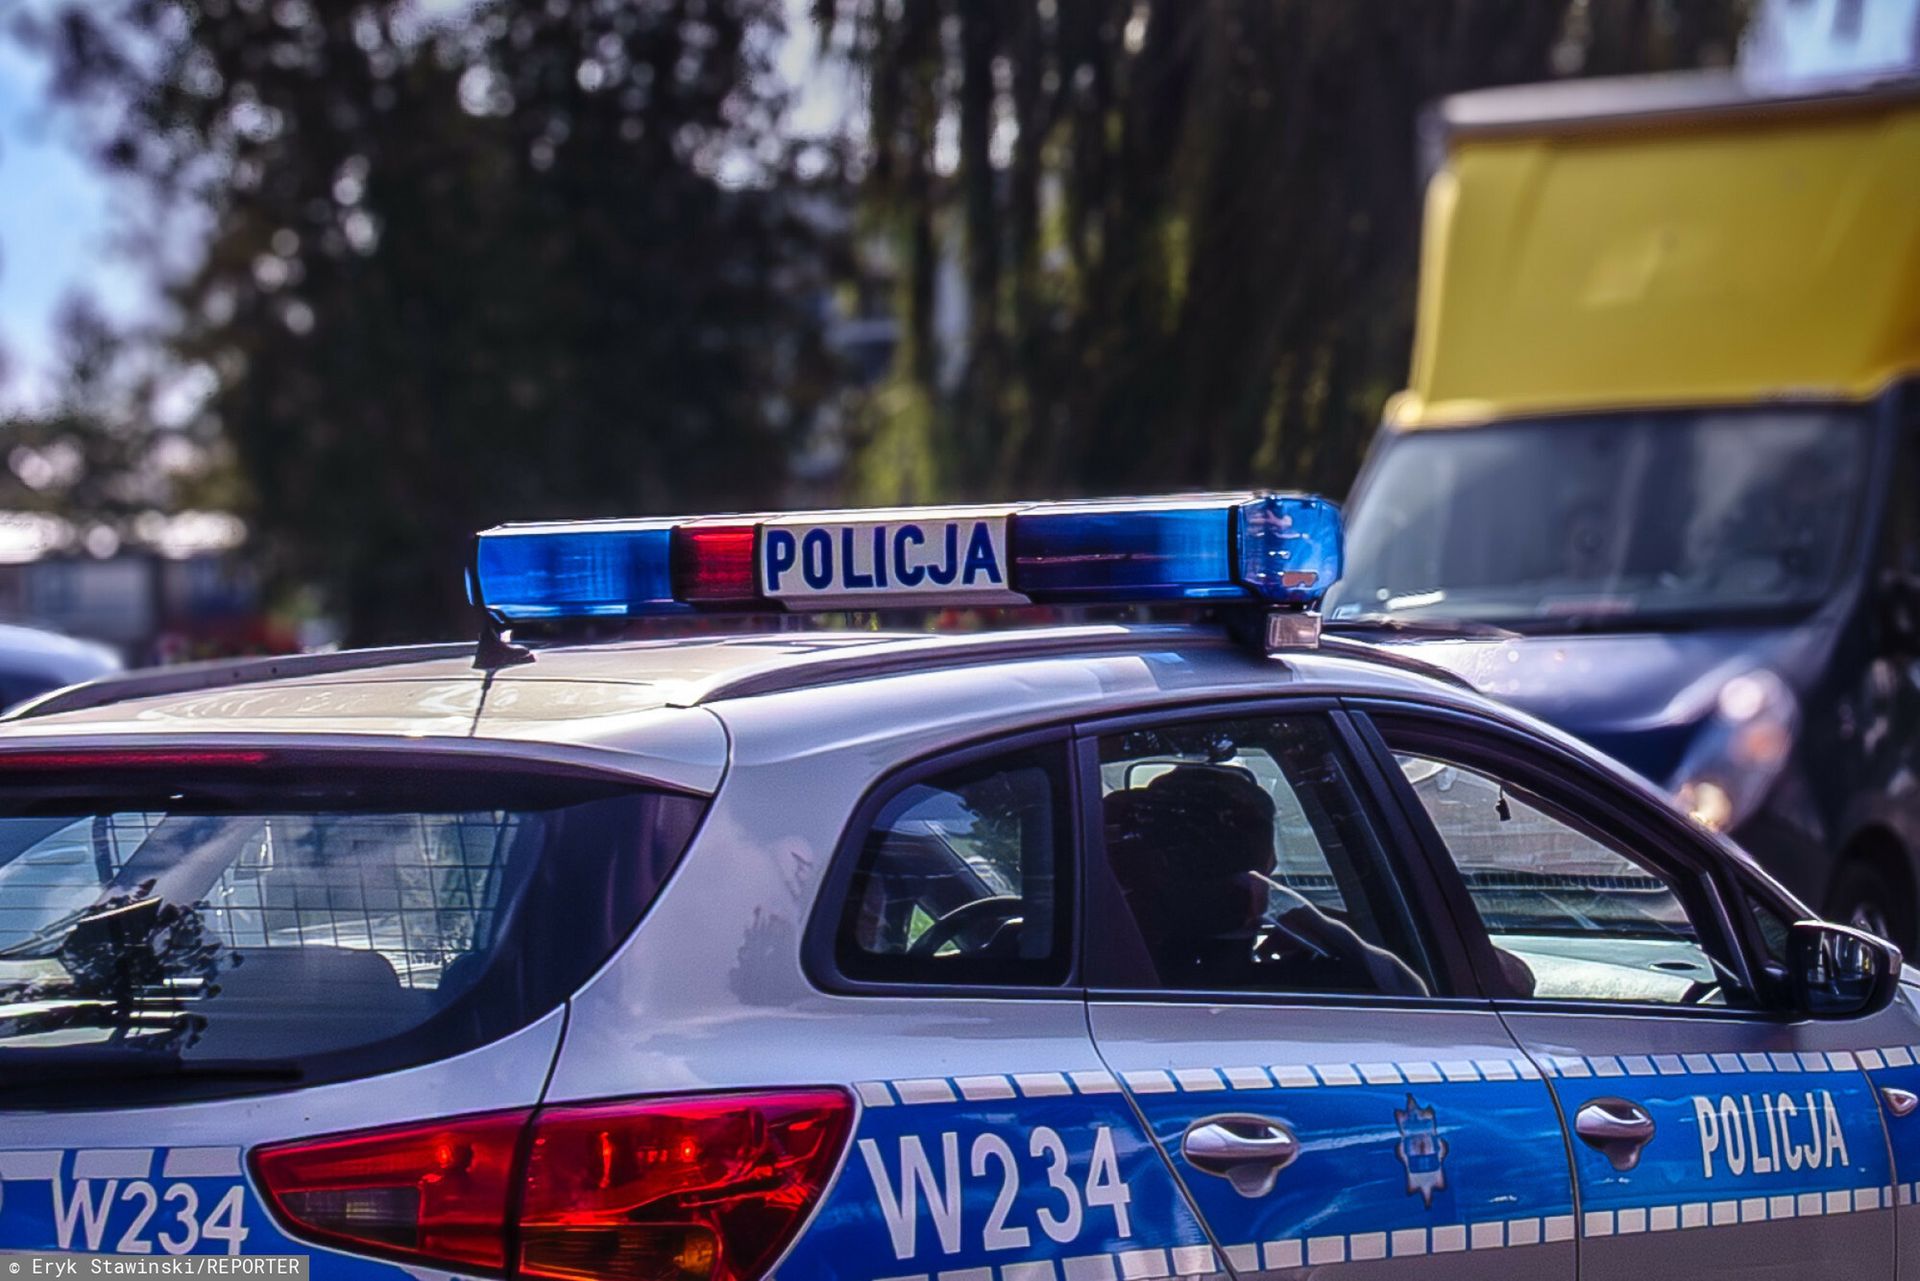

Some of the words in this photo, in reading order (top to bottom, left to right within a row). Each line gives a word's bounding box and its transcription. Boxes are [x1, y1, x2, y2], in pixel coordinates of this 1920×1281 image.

[766, 522, 1002, 591] POLICJA
[1692, 1090, 1850, 1178] POLICJA
[52, 1177, 249, 1256] W234
[857, 1126, 1131, 1260] W234
